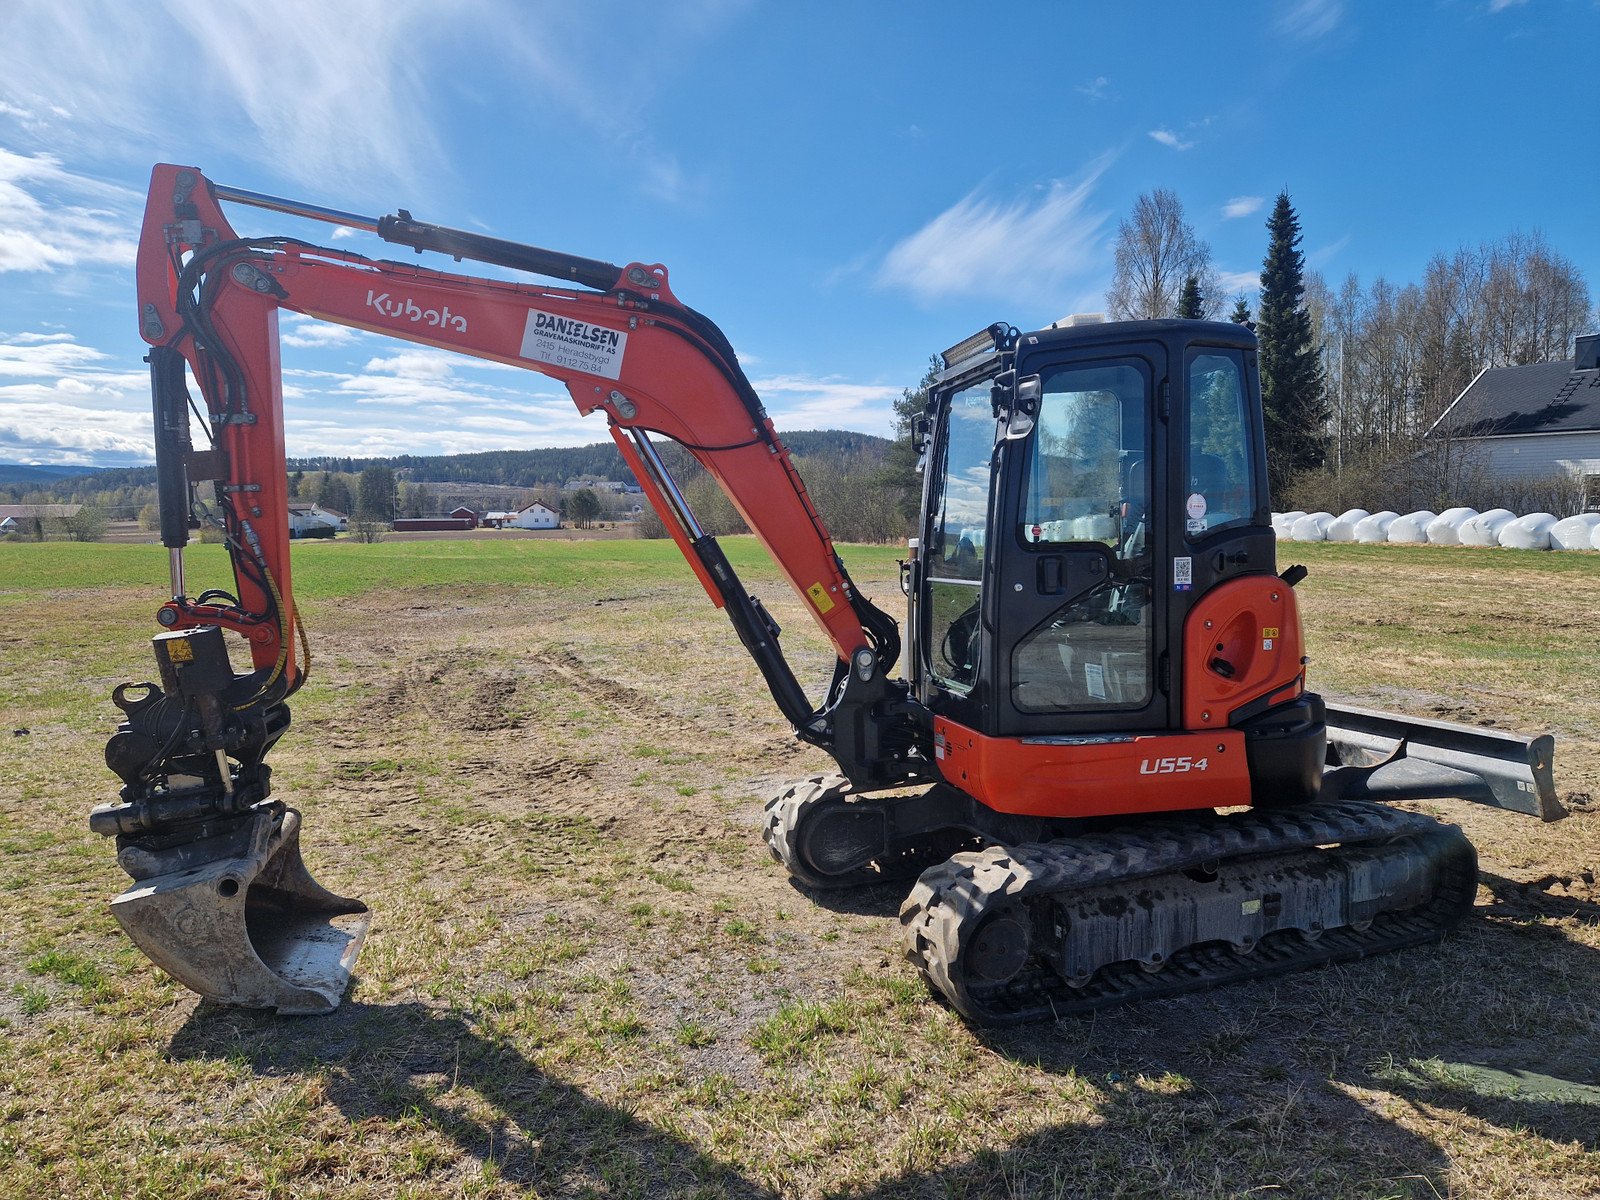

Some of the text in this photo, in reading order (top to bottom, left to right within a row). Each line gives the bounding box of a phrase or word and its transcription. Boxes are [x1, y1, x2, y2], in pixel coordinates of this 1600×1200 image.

[366, 289, 468, 333] Kubota
[533, 328, 616, 355] GRAVEMASKINDRIFT AS
[535, 313, 619, 347] DANIELSEN
[536, 338, 555, 350] 2415
